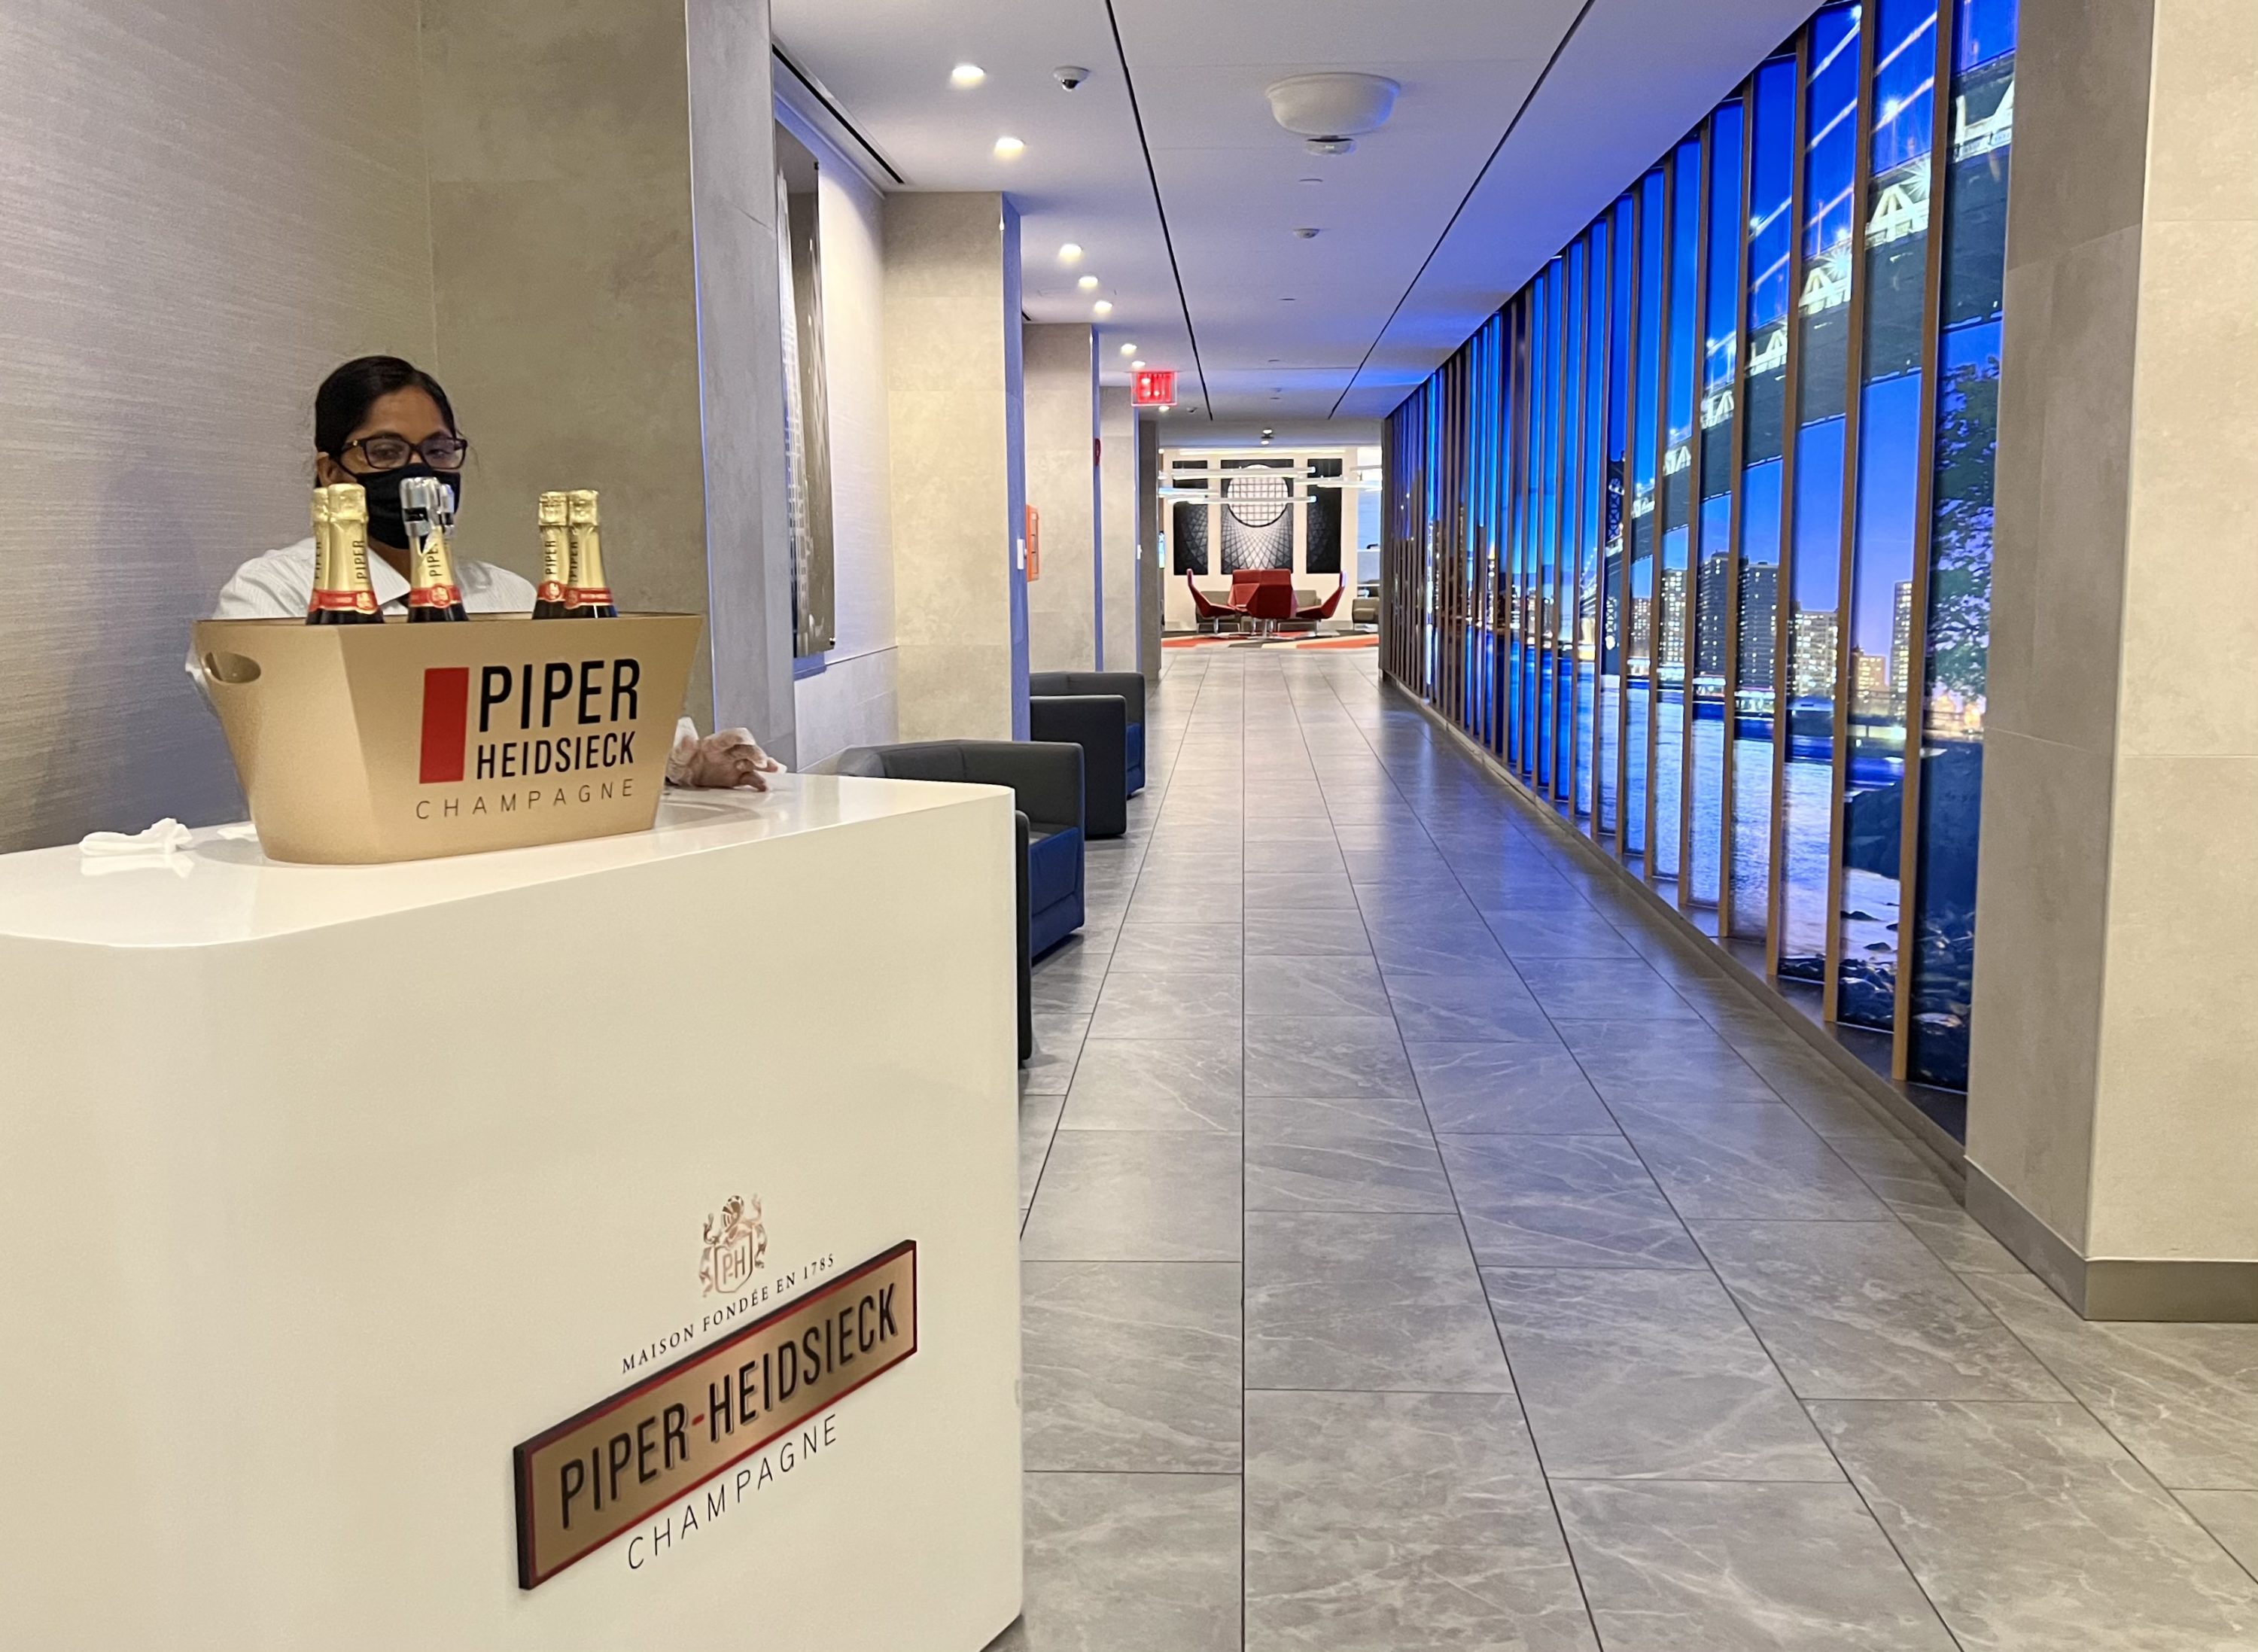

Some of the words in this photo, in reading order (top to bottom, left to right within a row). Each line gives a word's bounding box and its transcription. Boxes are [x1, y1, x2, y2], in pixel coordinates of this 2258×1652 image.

[351, 540, 368, 580] PIPER
[544, 540, 557, 575] PIPER
[478, 658, 641, 733] PIPER
[476, 731, 637, 780] HEIDSIECK
[415, 778, 634, 820] CHAMPAGNE
[622, 1325, 695, 1374] MAISON
[702, 1286, 770, 1332] FONDÉE
[776, 1272, 796, 1295] EN
[802, 1253, 834, 1280] 1785
[560, 1282, 899, 1531] PIPER-HEIDSIECK
[627, 1413, 838, 1571] CHAMPAGNE
